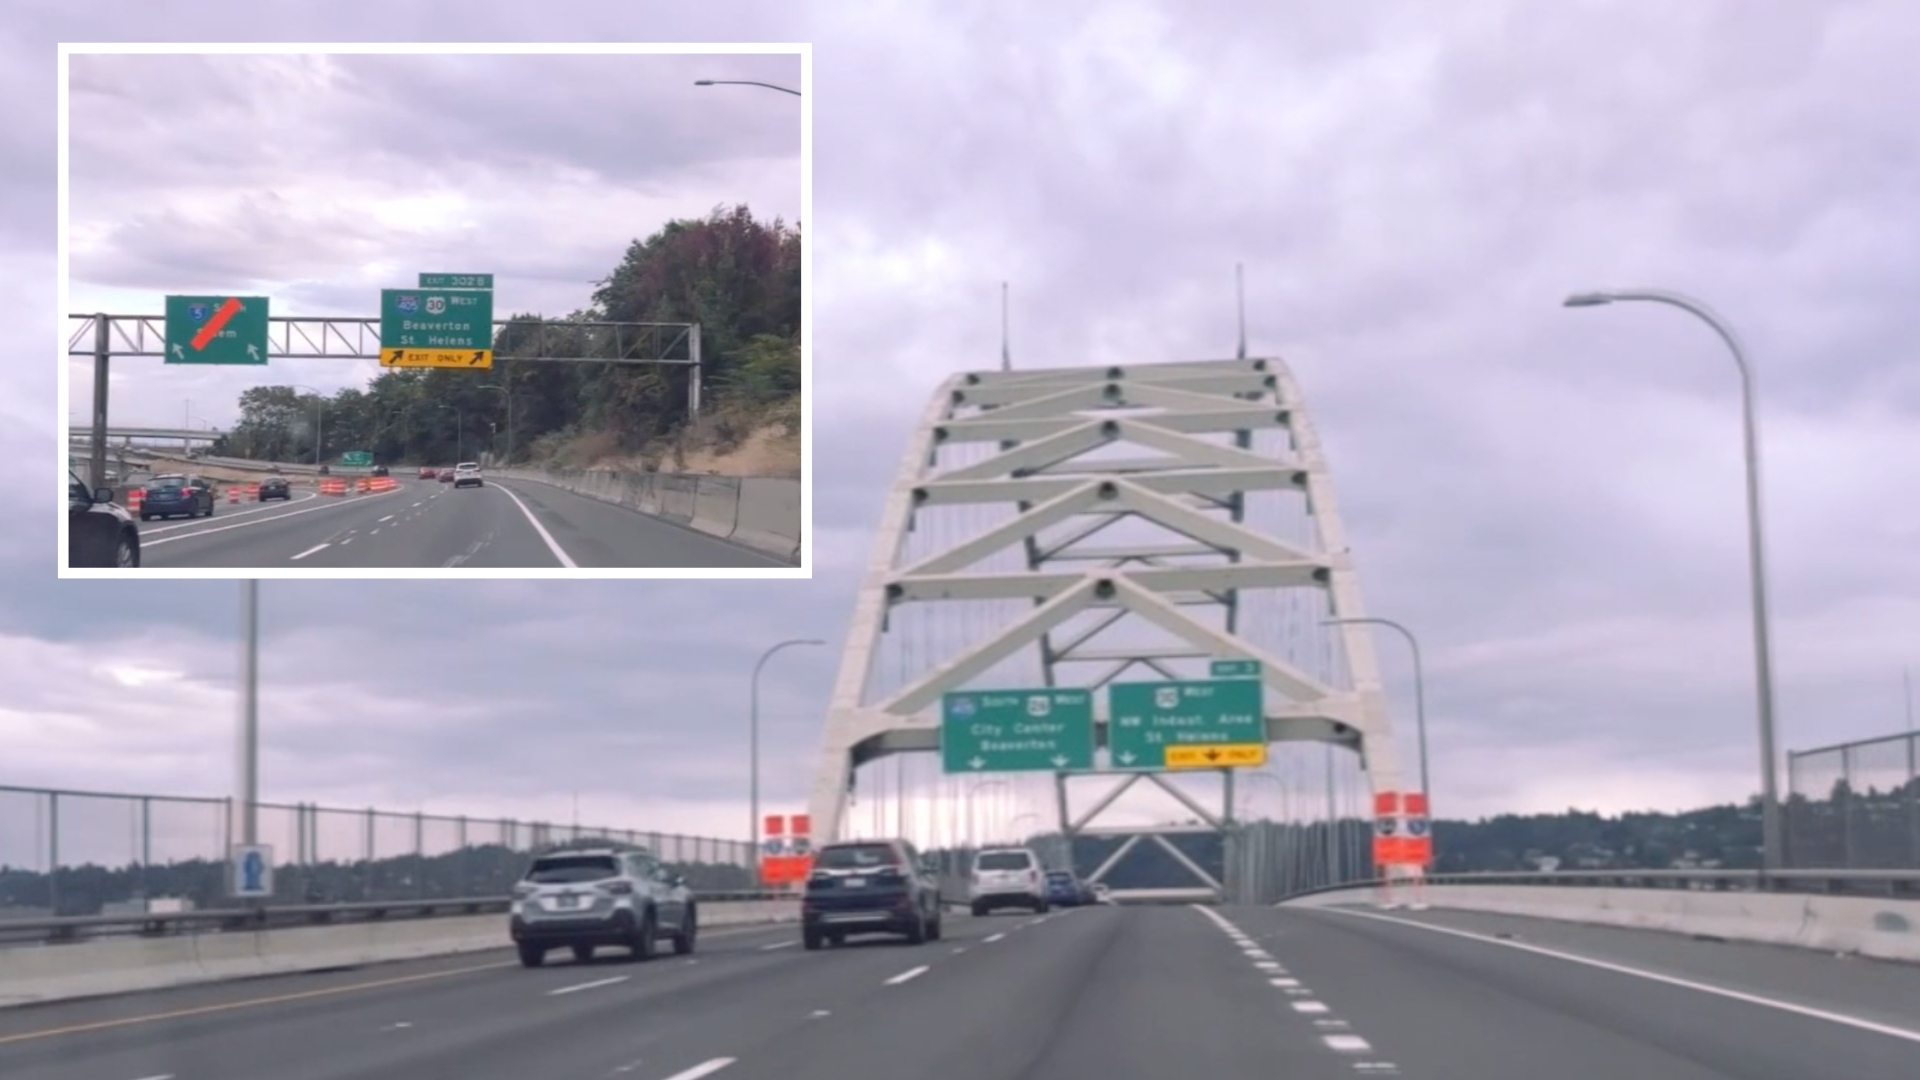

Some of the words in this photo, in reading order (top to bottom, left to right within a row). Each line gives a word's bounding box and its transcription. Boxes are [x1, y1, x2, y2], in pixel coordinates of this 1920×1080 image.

[194, 307, 203, 319] 5
[403, 320, 470, 331] Beaverton
[428, 334, 473, 346] Helens
[408, 353, 430, 362] EXIT
[437, 354, 463, 362] ONLY
[1218, 713, 1253, 725] Area
[970, 723, 1003, 737] City
[1014, 722, 1064, 735] Center
[981, 739, 1056, 752] Beaverton
